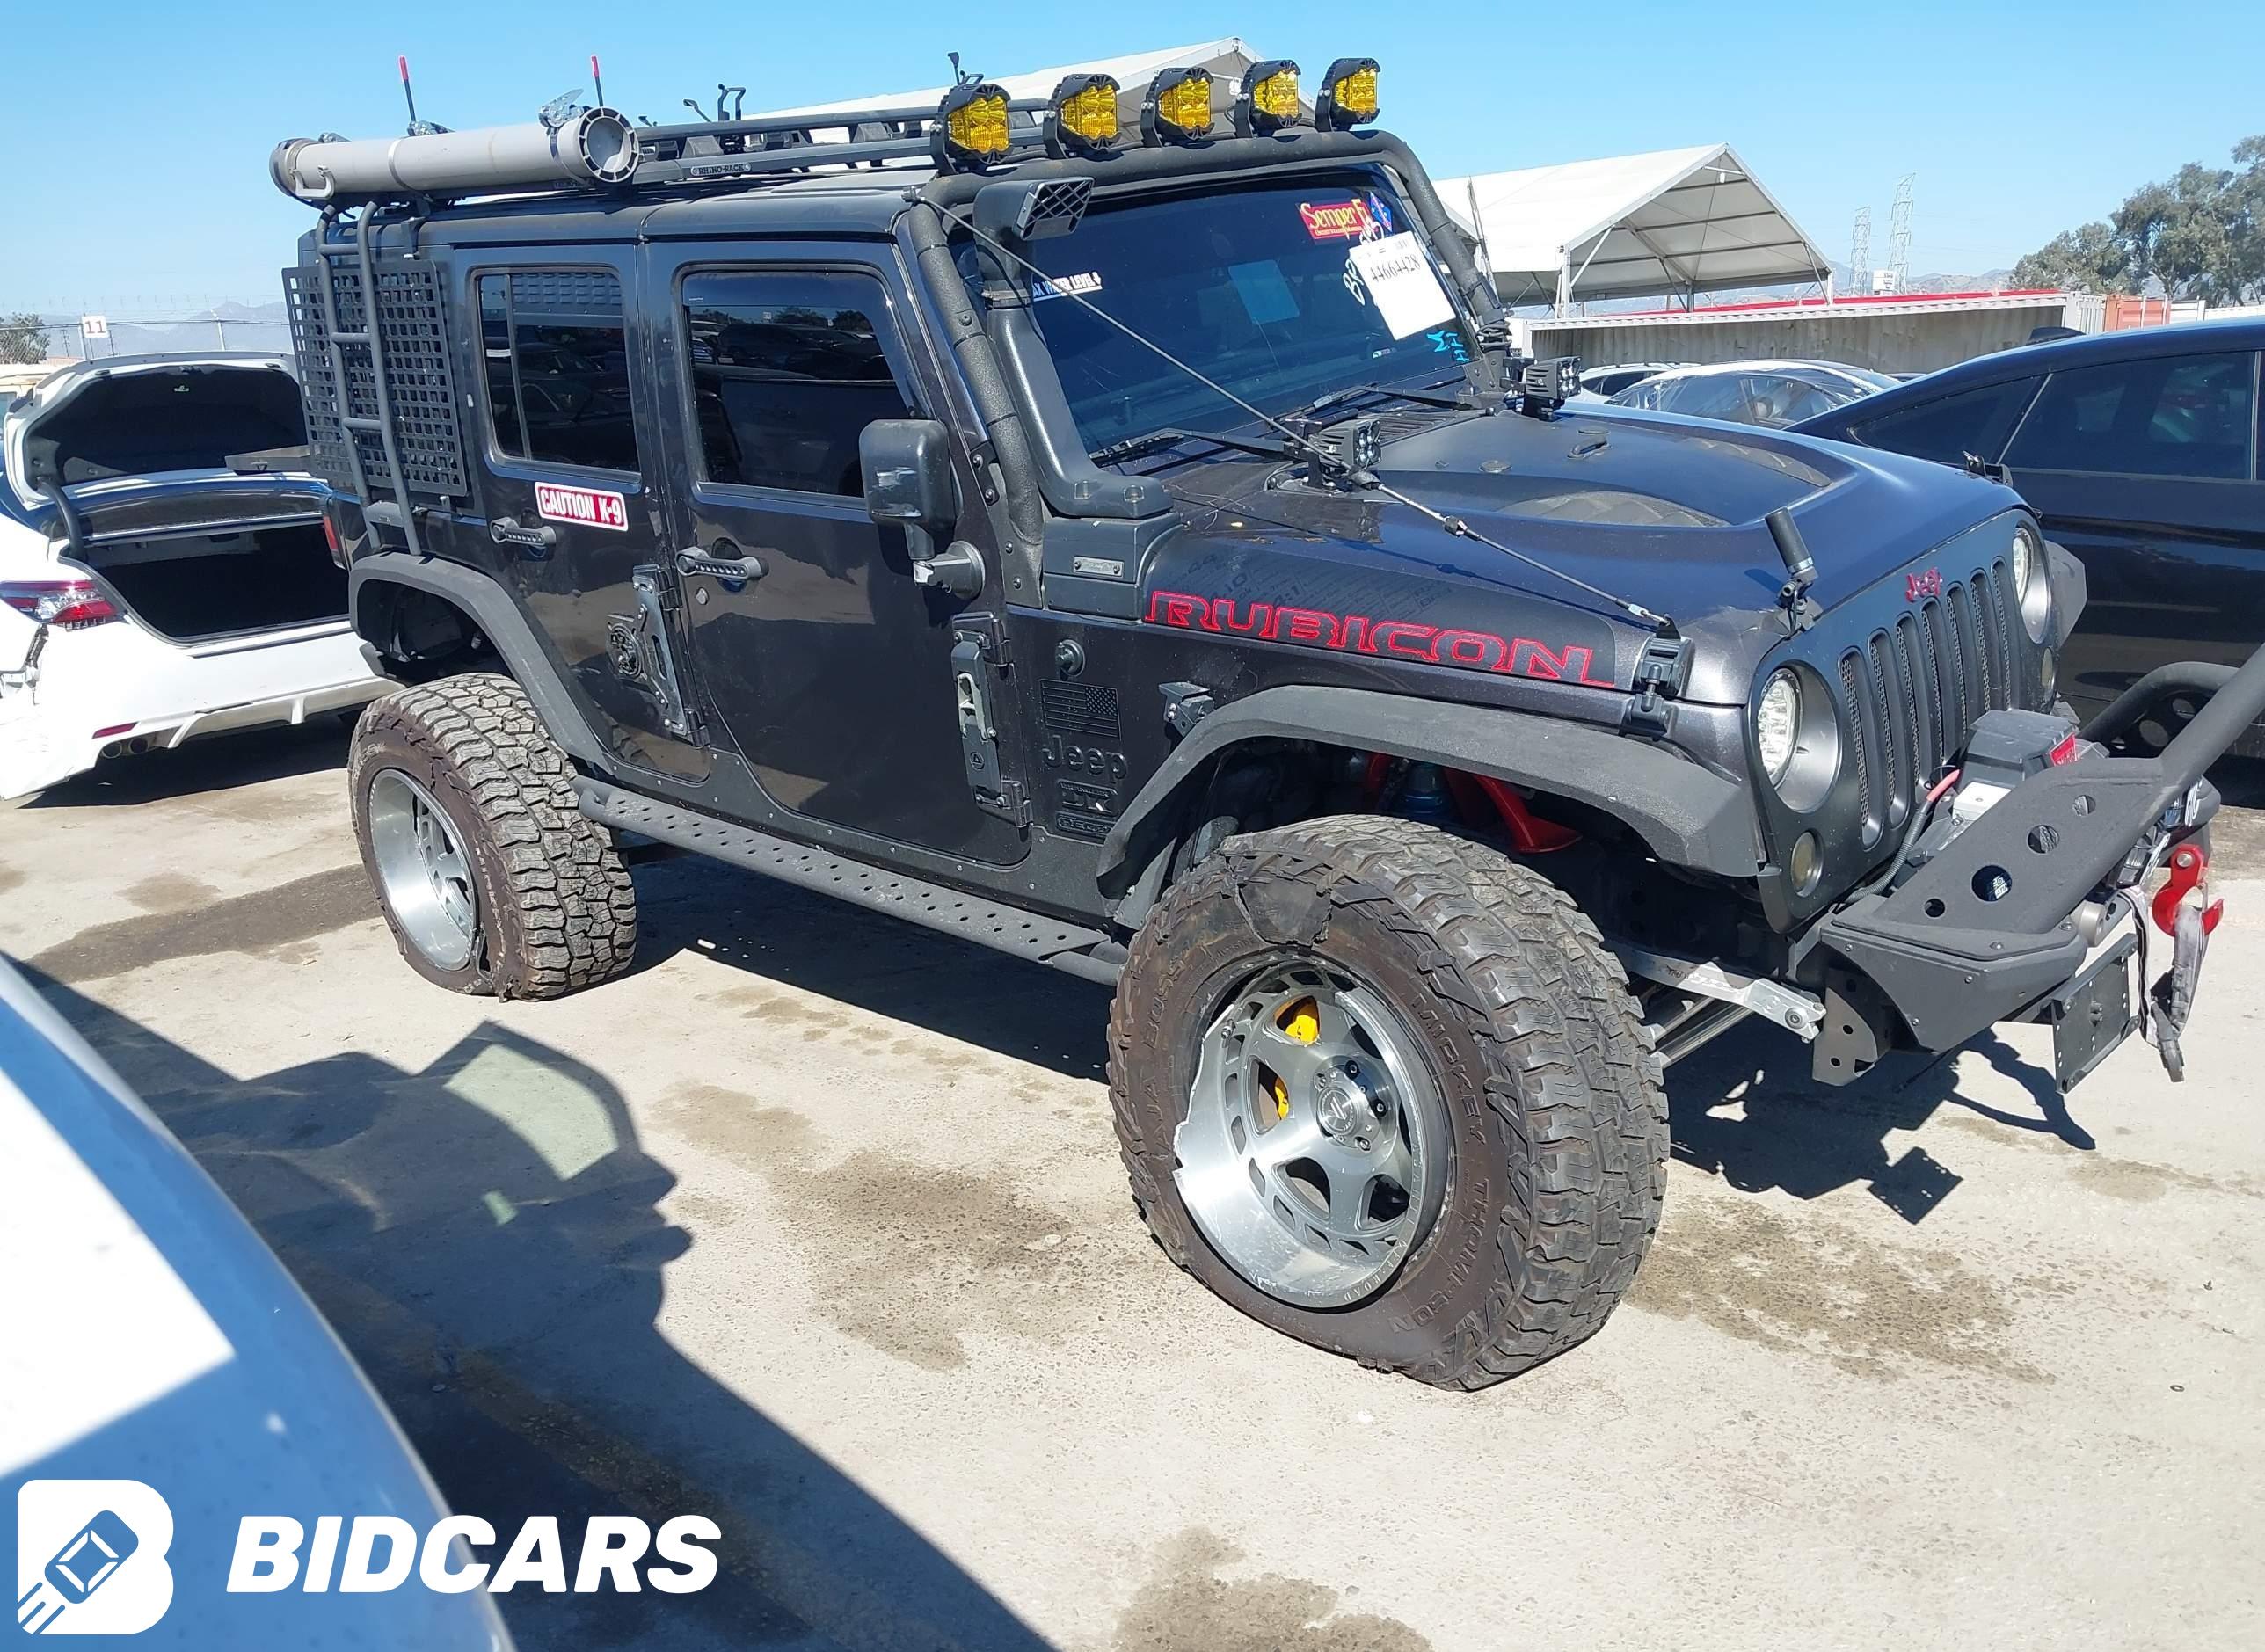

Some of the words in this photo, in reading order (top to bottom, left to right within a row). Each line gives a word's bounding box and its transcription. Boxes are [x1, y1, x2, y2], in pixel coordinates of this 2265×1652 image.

[699, 164, 744, 175] RHINO-RACK
[1300, 202, 1358, 240] Semper
[1069, 273, 1096, 289] LEVEL
[84, 320, 106, 334] 11
[539, 488, 596, 520] CAUTION
[598, 497, 623, 524] K-9
[1904, 567, 1941, 603] Jeep
[1145, 590, 1616, 689] RUBICON
[1041, 734, 1127, 787] Jeep
[1410, 997, 1487, 1146] MICKEY
